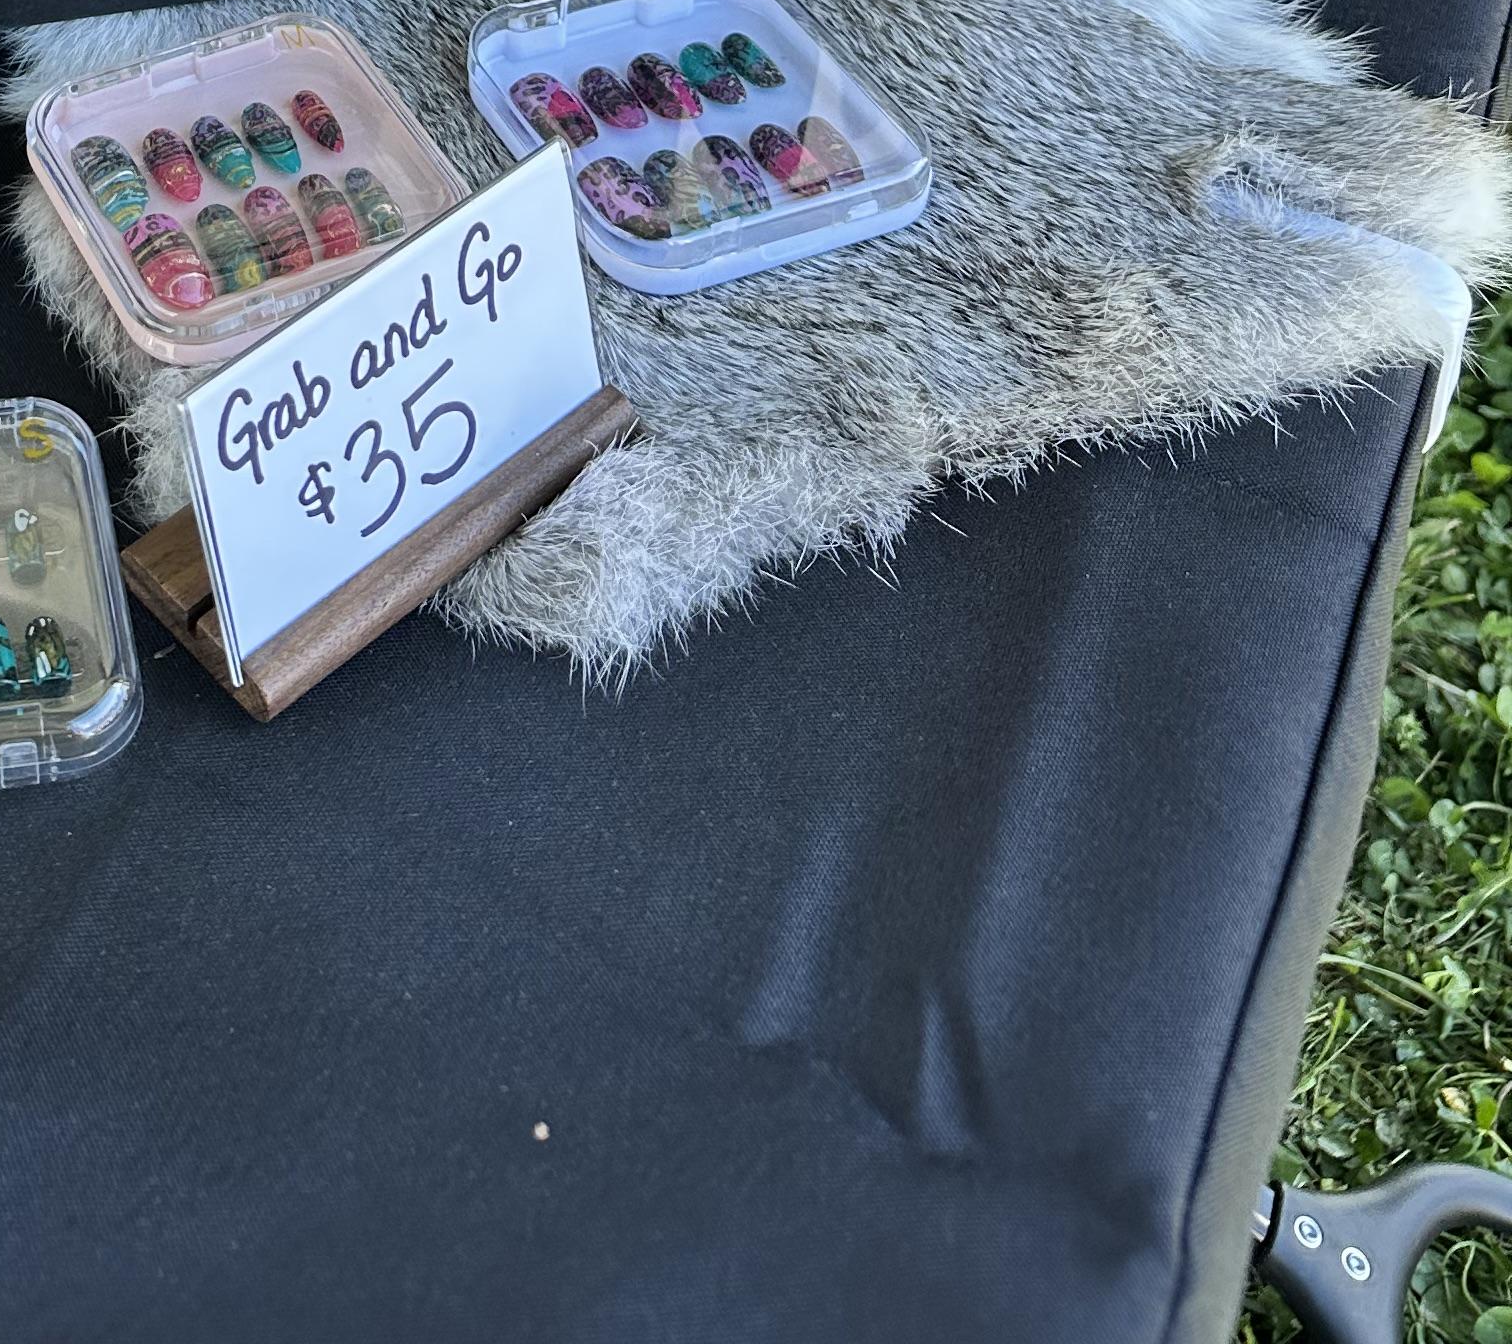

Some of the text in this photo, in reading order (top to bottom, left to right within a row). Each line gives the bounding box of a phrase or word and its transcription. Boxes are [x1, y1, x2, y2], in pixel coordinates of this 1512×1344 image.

[18, 416, 54, 460] S
[217, 221, 522, 485] Grab and Go
[298, 358, 477, 538] $35
